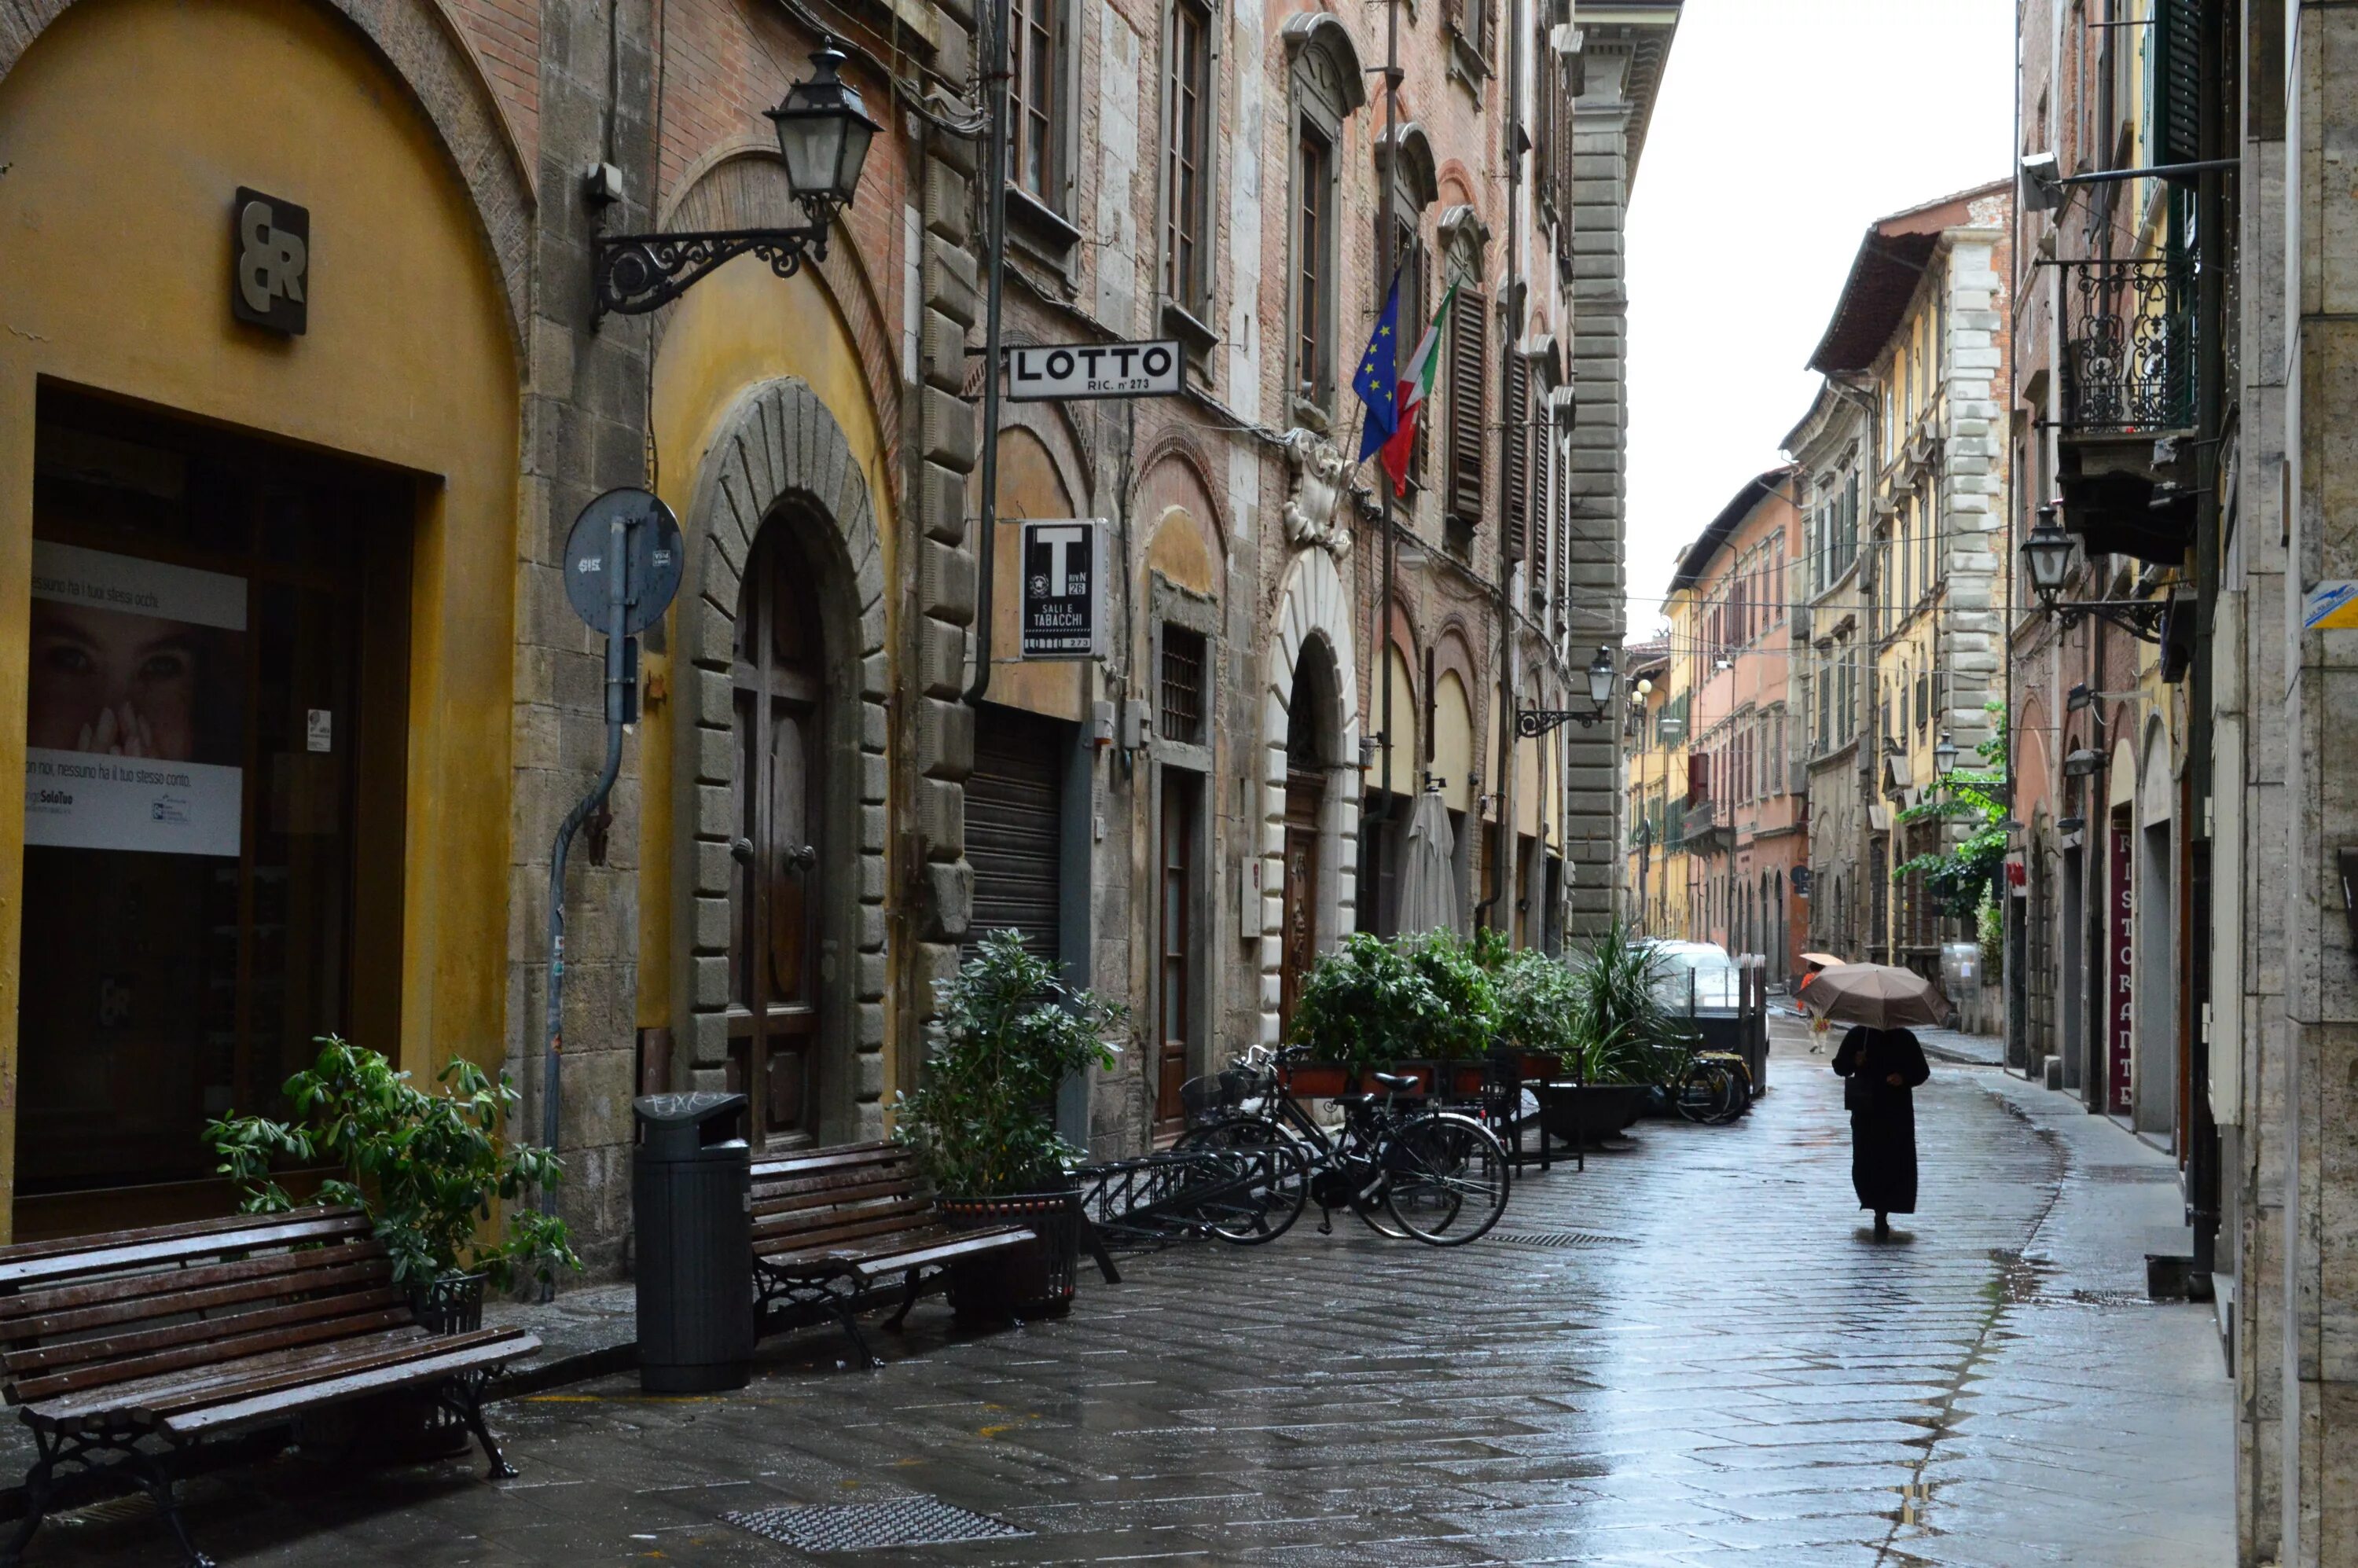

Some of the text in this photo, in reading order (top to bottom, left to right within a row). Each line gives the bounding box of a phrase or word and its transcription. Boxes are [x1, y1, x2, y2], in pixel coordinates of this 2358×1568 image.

[1017, 347, 1172, 380] LOTTO
[1088, 380, 1114, 390] RIC.
[1130, 379, 1149, 389] 273
[1037, 528, 1082, 597] T
[31, 577, 65, 593] essuno
[68, 579, 79, 596] ha
[87, 584, 105, 600] tuoi
[107, 587, 134, 604] stessi
[1071, 583, 1083, 594] 26
[1034, 613, 1082, 626] TABACCHI
[1042, 604, 1073, 613] SALI E
[25, 760, 192, 788] on noi, nessuno ha il tuo stesso conto.
[2119, 834, 2132, 1106] RISTORANTE
